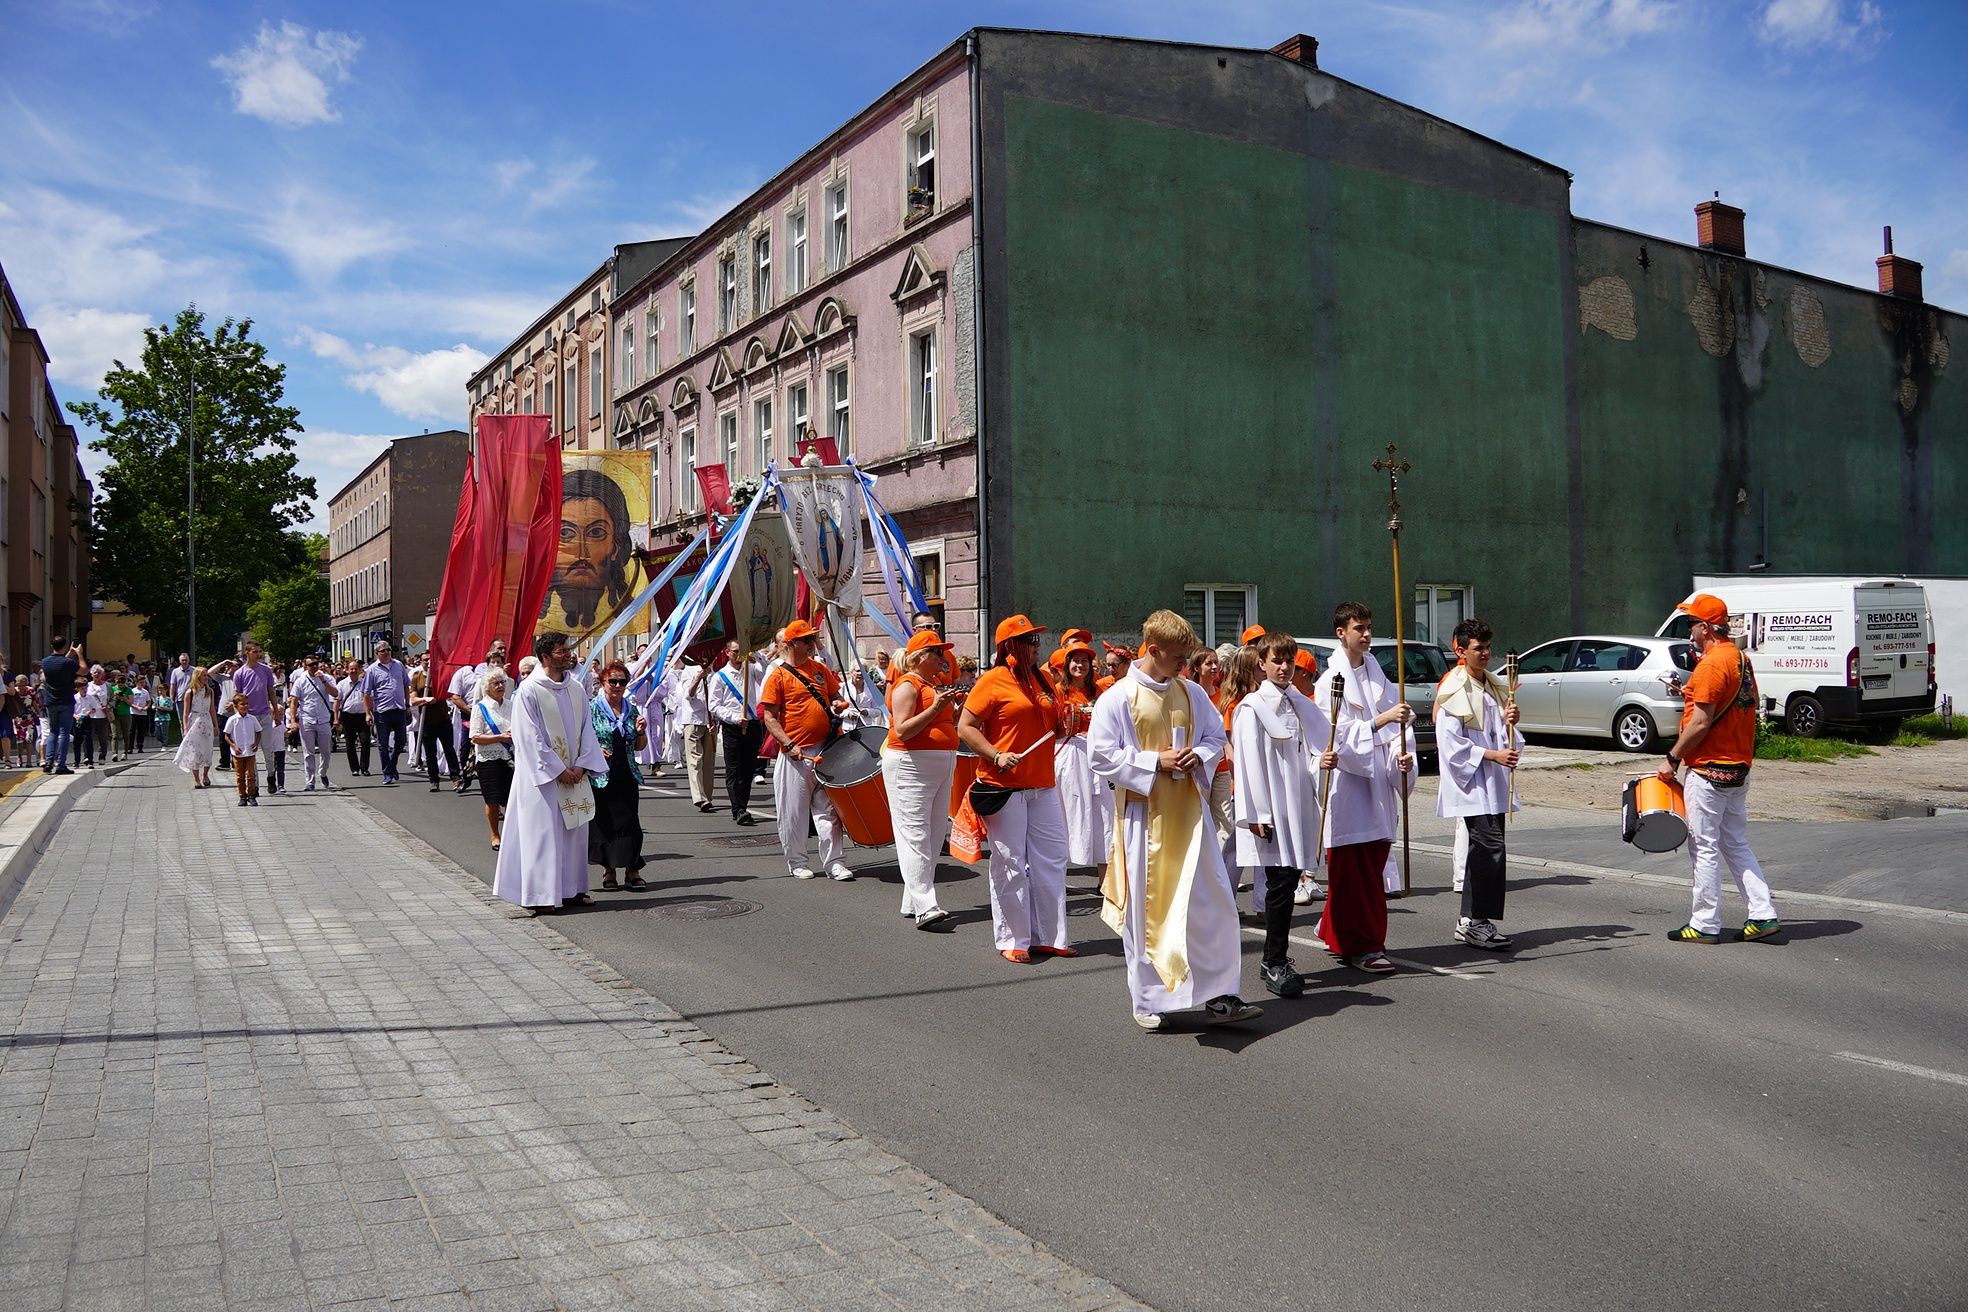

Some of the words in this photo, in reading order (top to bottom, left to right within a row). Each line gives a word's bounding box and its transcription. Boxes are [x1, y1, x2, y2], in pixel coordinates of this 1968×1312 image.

[795, 501, 805, 534] MARYJO
[801, 486, 813, 499] BEZ
[1772, 615, 1832, 625] REMO-FACH
[1867, 612, 1918, 623] REMO-FACH
[1901, 632, 1922, 640] ZABUDOWY
[1883, 642, 1916, 650] 693-777-516
[1773, 659, 1784, 668] tel.
[1785, 659, 1829, 668] 693-777-516
